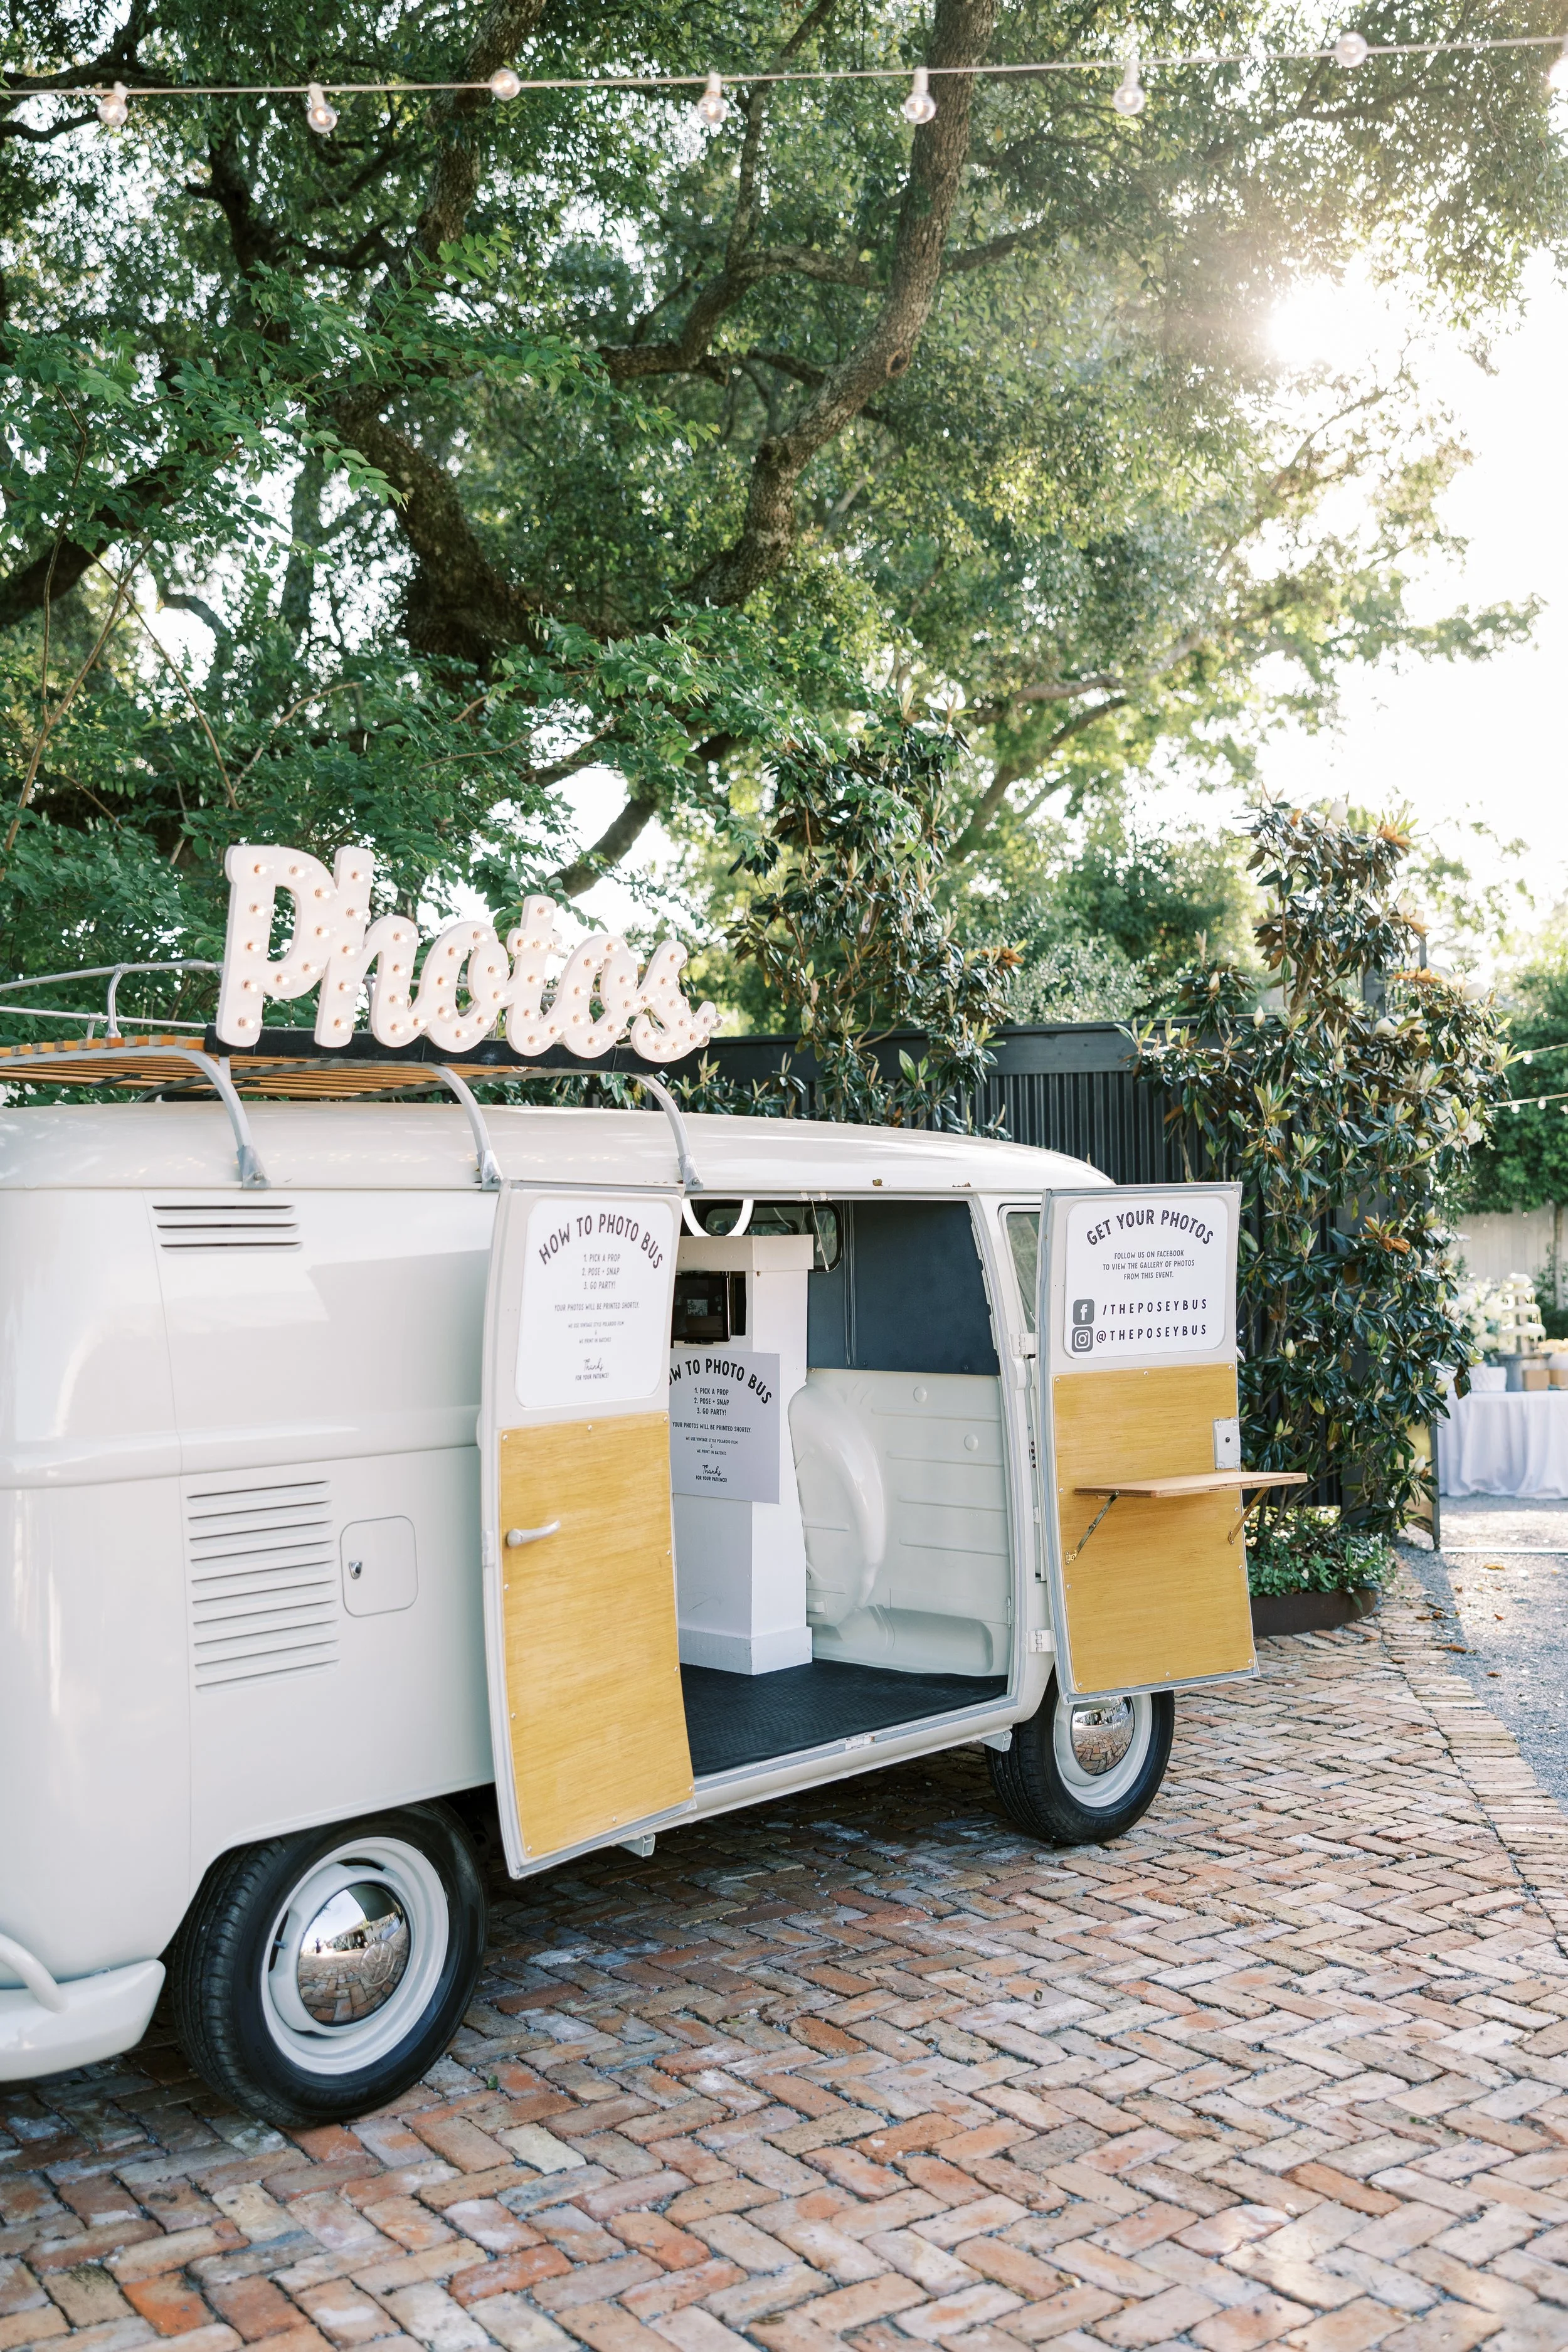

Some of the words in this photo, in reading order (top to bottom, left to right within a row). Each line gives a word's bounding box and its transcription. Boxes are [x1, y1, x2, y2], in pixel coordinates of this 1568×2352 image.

[216, 844, 718, 1062] Photos
[1086, 1219, 1111, 1245] GET
[1116, 1209, 1155, 1230] YOUR
[1160, 1210, 1214, 1244] PHOTOS
[539, 1223, 570, 1264] HOW
[576, 1215, 592, 1237] TO
[599, 1214, 638, 1242] PHOTO
[641, 1231, 663, 1269] BUS
[584, 1254, 587, 1262] 1.
[590, 1254, 600, 1262] PICK
[1157, 1249, 1184, 1258] FACEBOOK
[582, 1268, 586, 1276] 2.
[588, 1268, 600, 1276] POSE
[590, 1281, 596, 1290] GO
[599, 1281, 615, 1289] PARTY!
[1103, 1298, 1207, 1315] /THEPOSEYBUS
[1096, 1324, 1206, 1343] @THEPOSEYBUS
[685, 1359, 700, 1375] TO
[706, 1359, 745, 1381] PHOTO
[748, 1374, 772, 1404] BUS
[702, 1465, 722, 1476] Thanks
